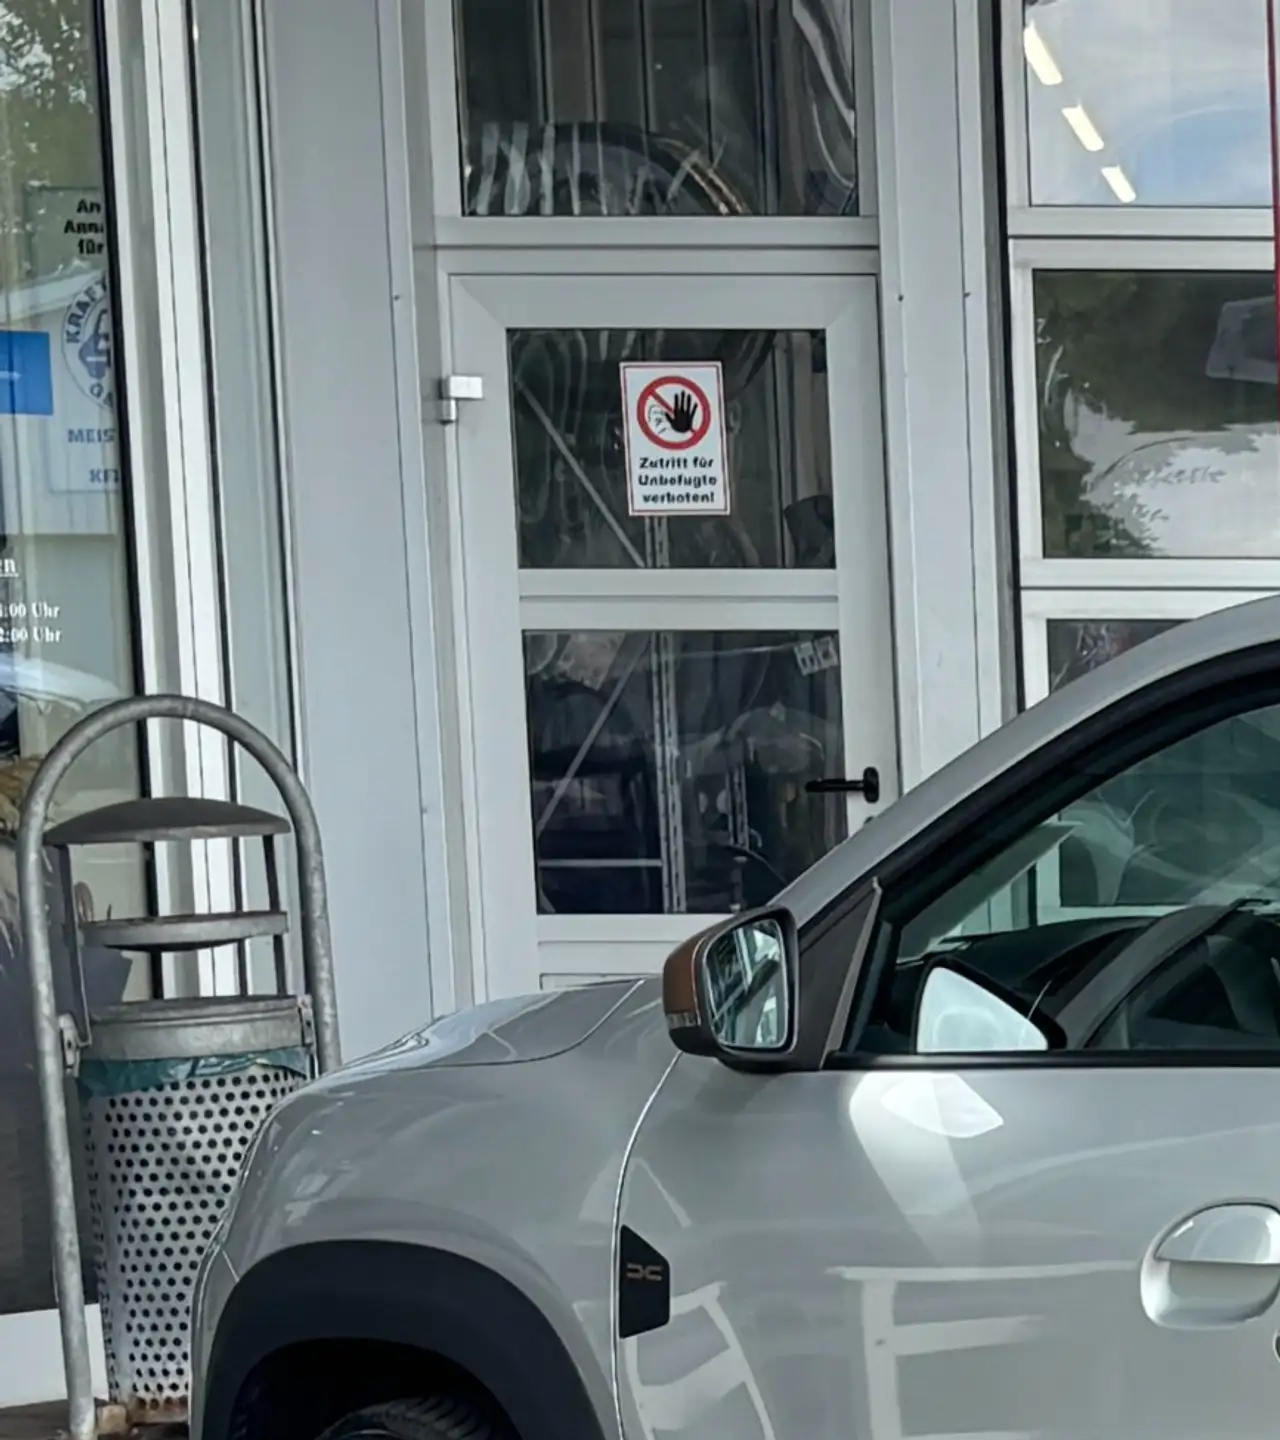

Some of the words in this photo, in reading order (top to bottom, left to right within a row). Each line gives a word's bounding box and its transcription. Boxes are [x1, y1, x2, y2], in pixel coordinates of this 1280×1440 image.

[639, 457, 688, 469] Zutritt
[692, 457, 714, 469] für
[638, 474, 718, 488] Unbefugte
[642, 491, 715, 503] verboten!
[31, 600, 60, 618] Uhr
[33, 625, 61, 643] Uhr
